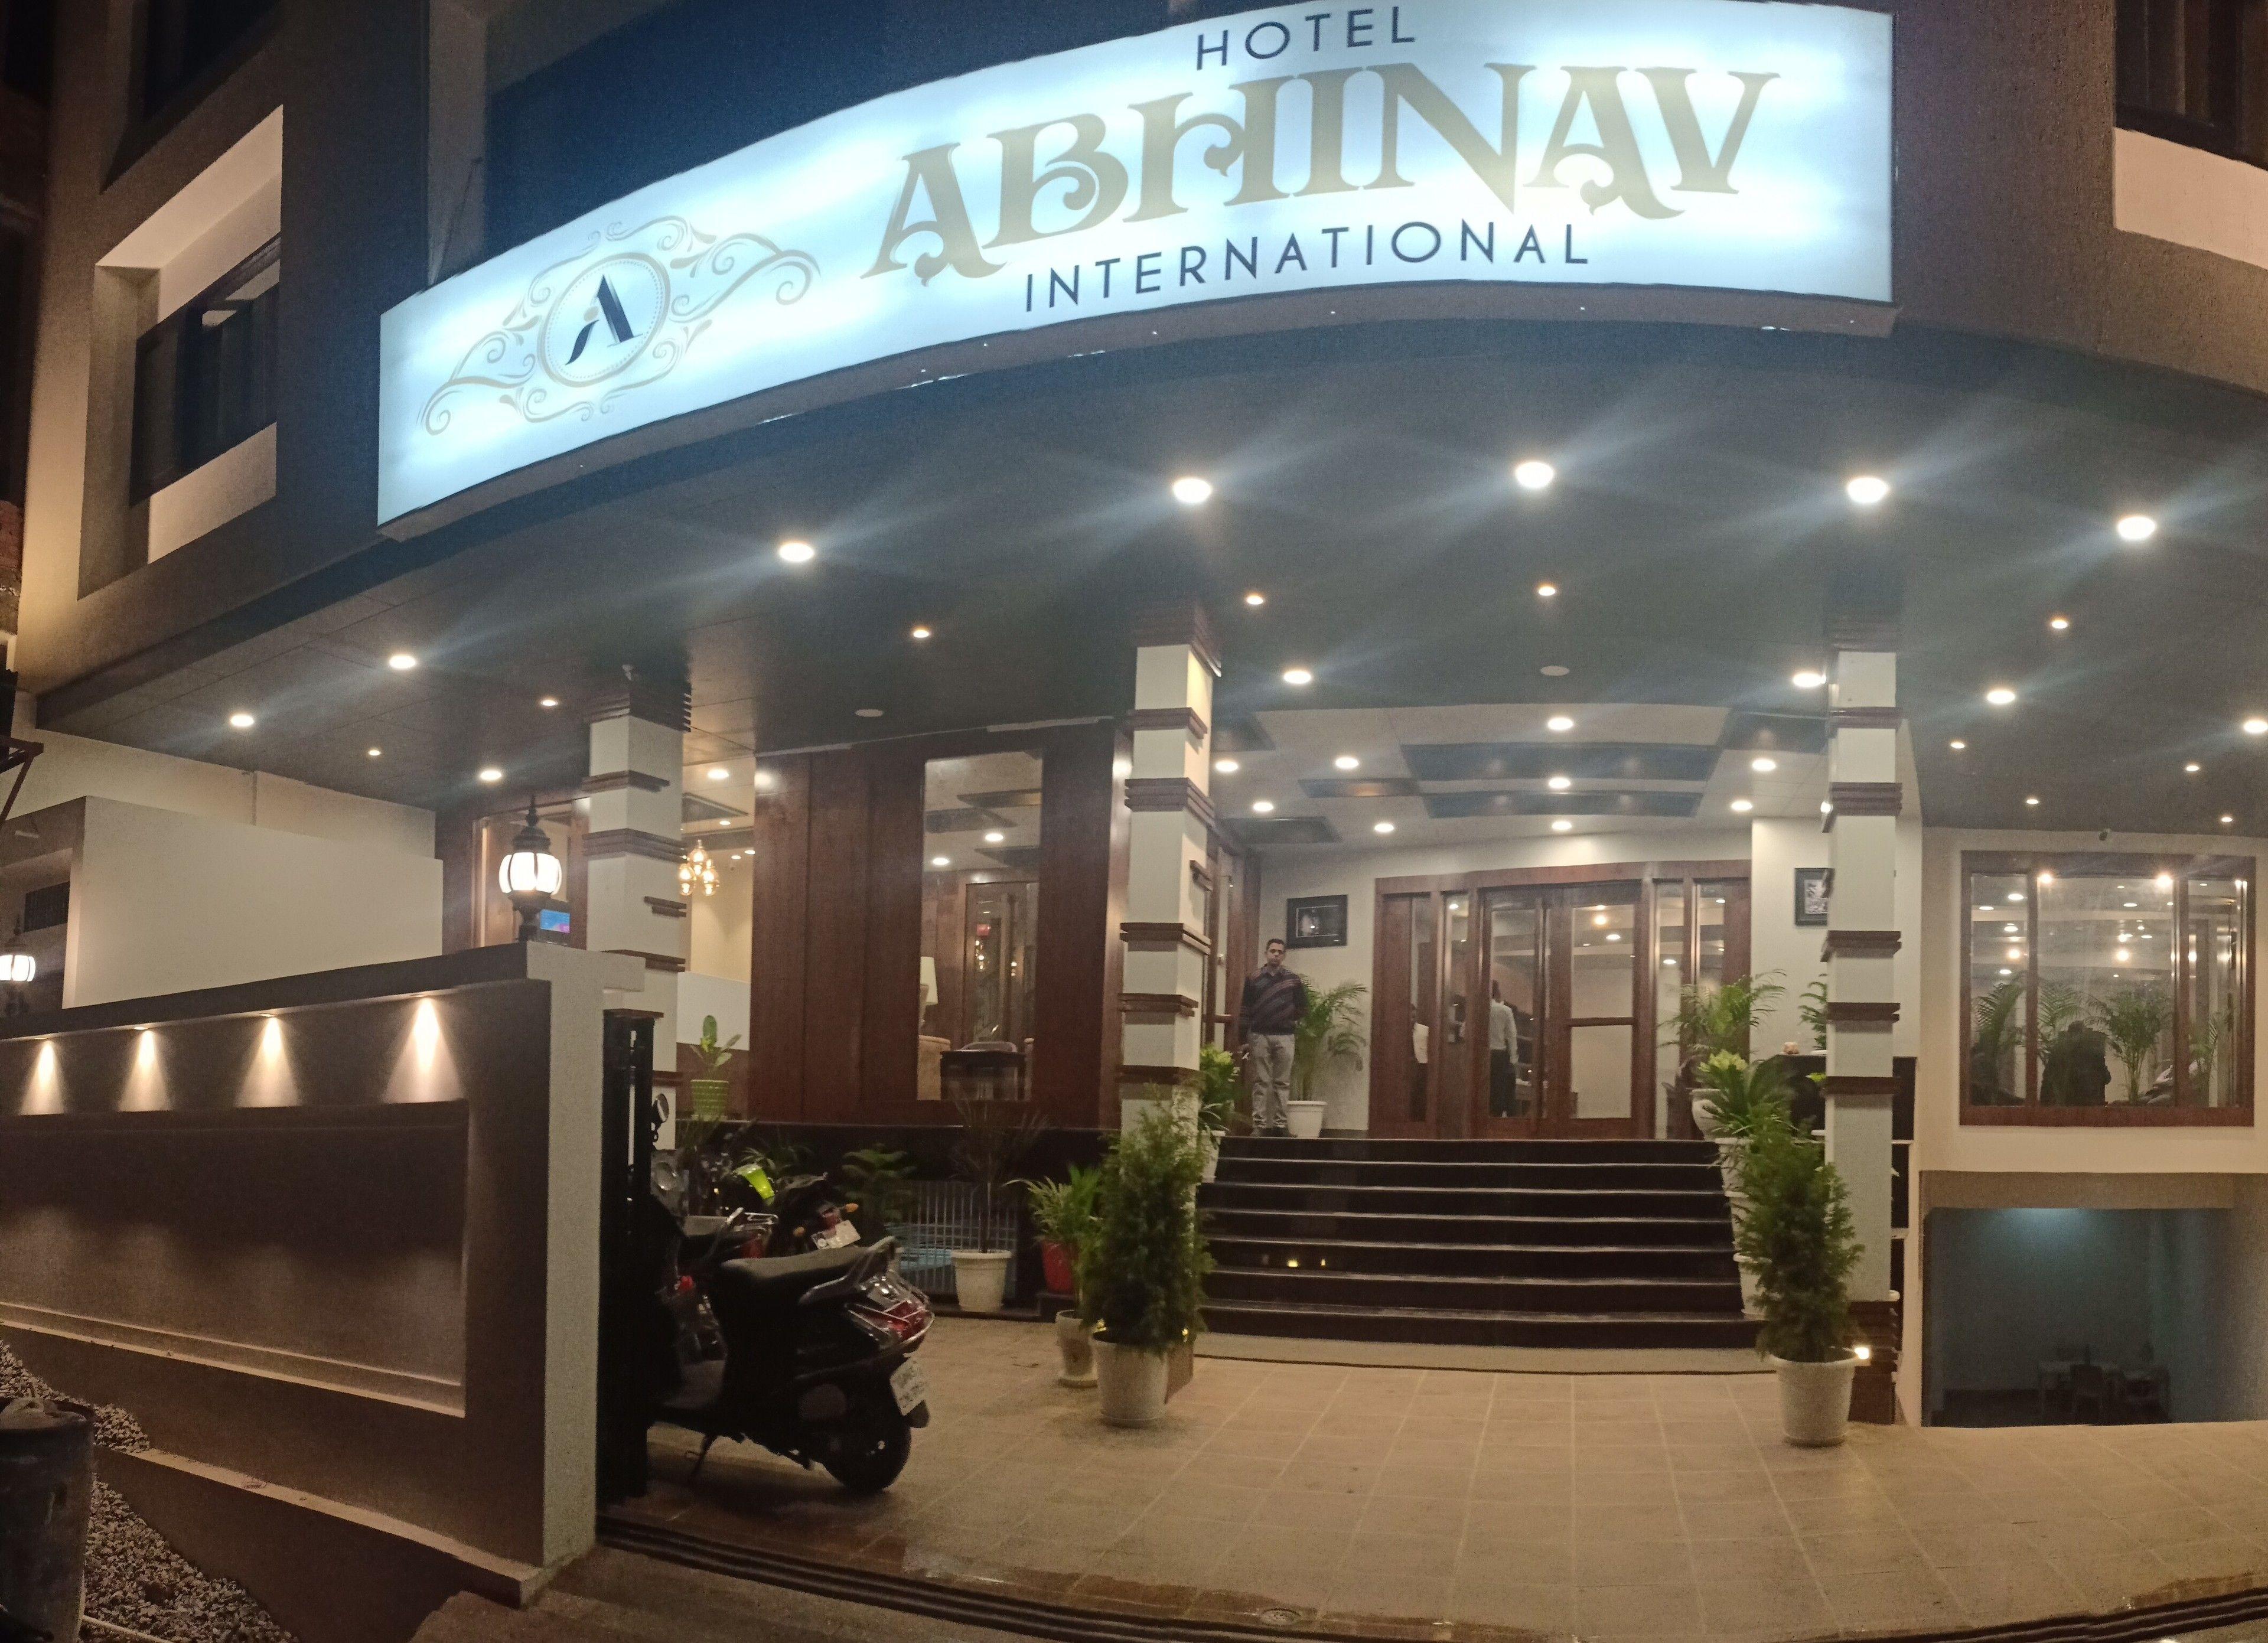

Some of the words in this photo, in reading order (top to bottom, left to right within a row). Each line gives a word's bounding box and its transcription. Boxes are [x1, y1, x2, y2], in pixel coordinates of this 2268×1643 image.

[1196, 5, 1416, 70] HOTEL
[861, 62, 1779, 285] ABHINAV
[1027, 220, 1588, 312] INTERNATIONAL
[566, 275, 643, 365] A
